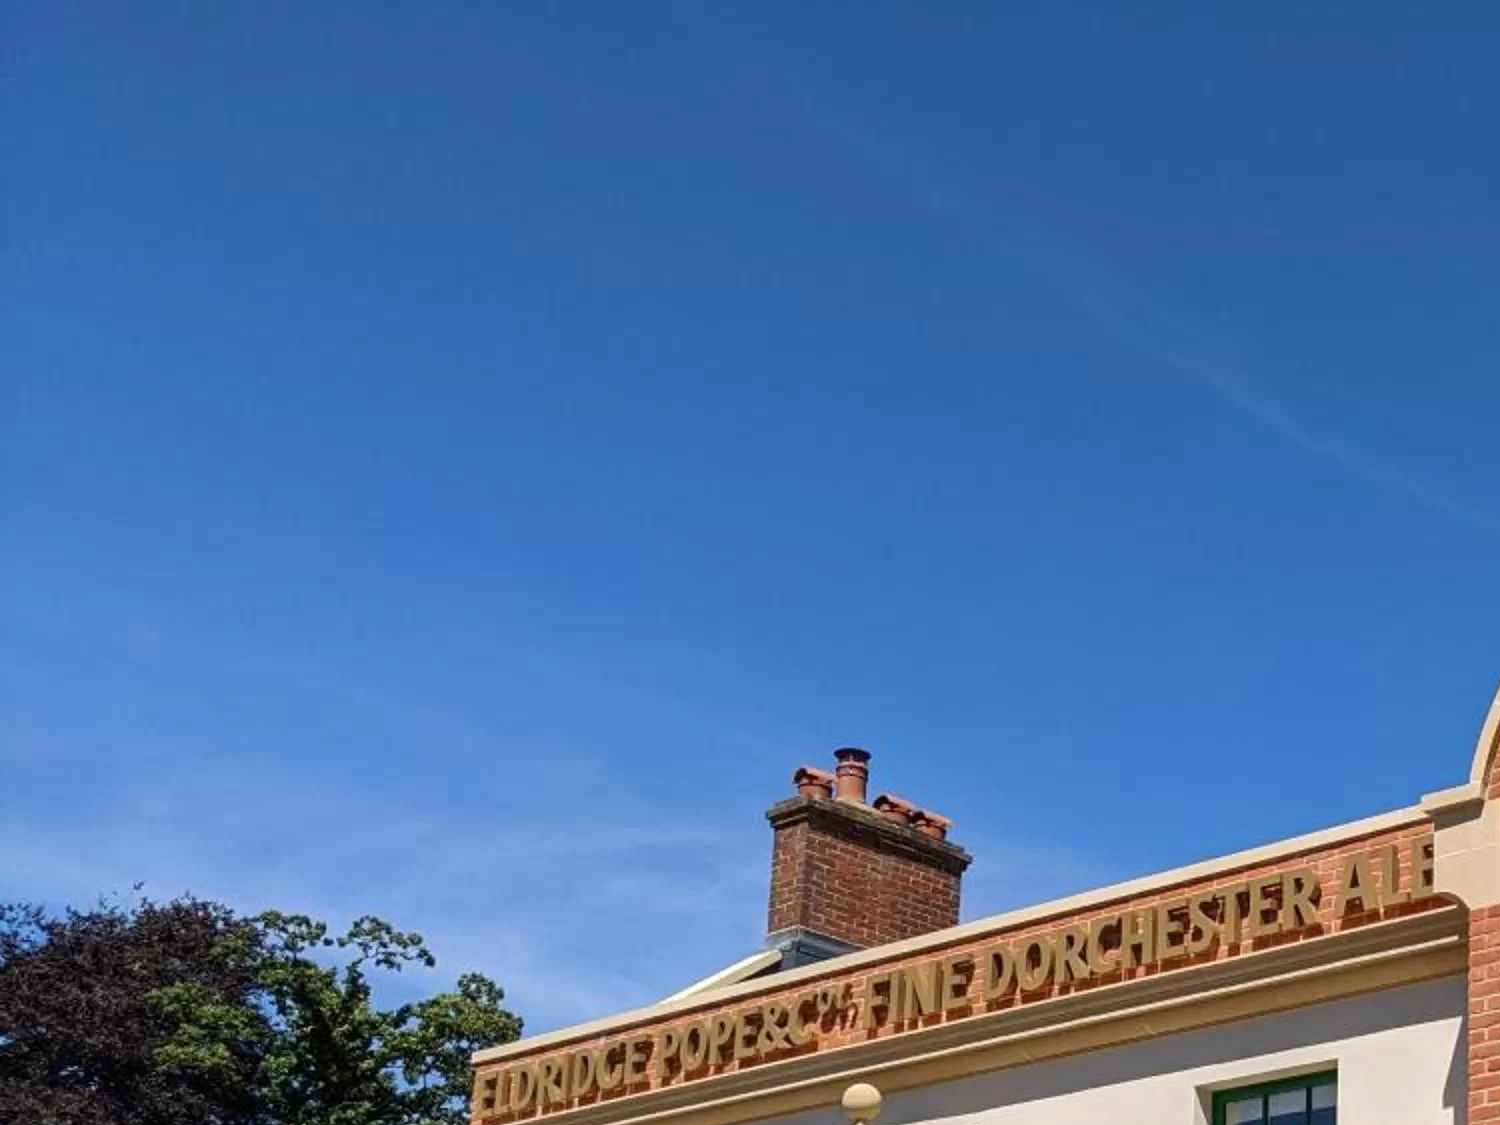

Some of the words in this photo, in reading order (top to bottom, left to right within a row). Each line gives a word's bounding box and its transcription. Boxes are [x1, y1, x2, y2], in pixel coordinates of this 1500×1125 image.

[473, 1034, 650, 1118] ELDRIDGE
[656, 1008, 763, 1078] POPE
[862, 953, 974, 1028] FINE
[982, 867, 1320, 1001] DORCHESTER
